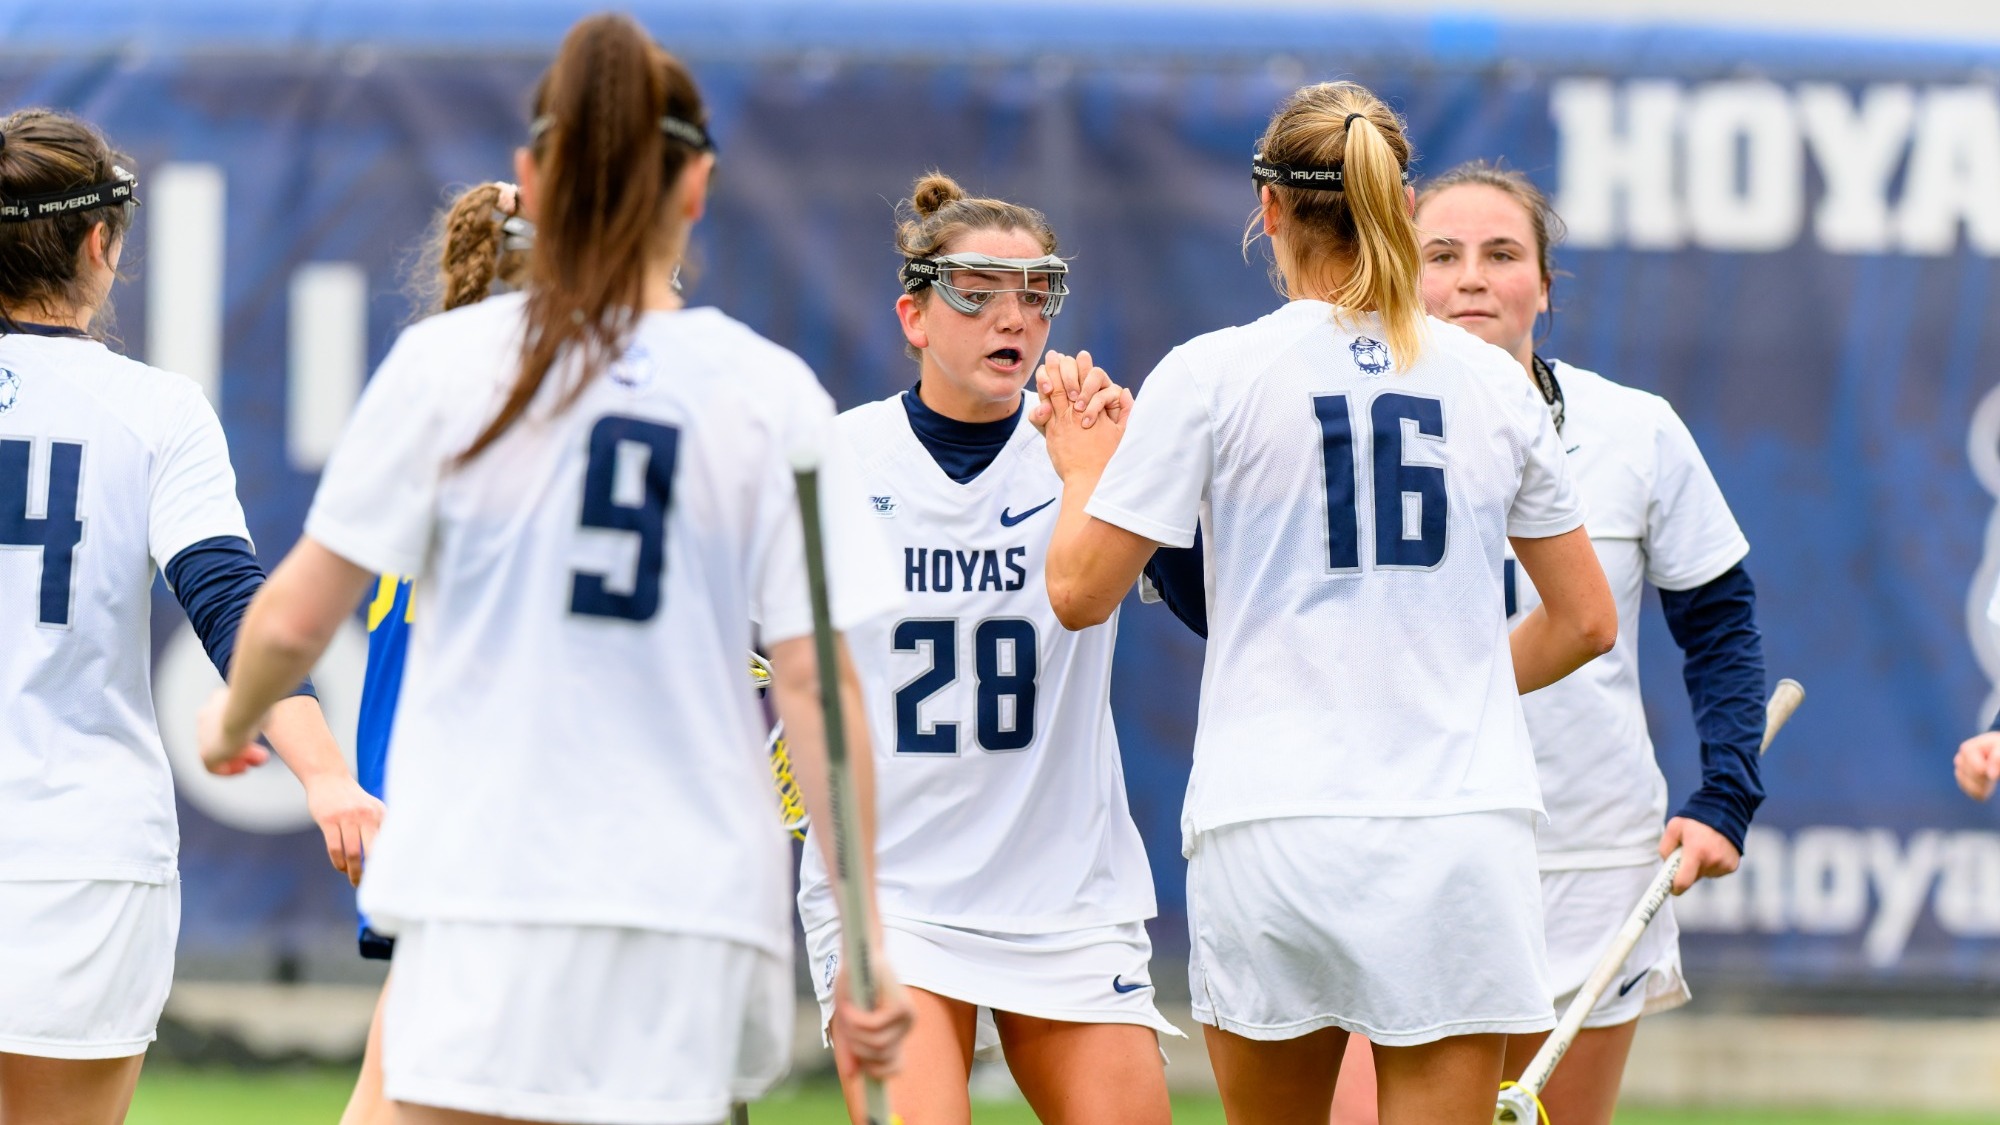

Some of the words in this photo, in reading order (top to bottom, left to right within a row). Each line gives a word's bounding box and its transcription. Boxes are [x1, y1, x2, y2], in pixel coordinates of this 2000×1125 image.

[1290, 171, 1341, 181] MAVERI
[910, 263, 936, 275] MAVERI
[567, 411, 684, 625] 9
[1309, 388, 1451, 574] 16
[904, 545, 1027, 593] HOYAS
[891, 616, 1042, 757] 28
